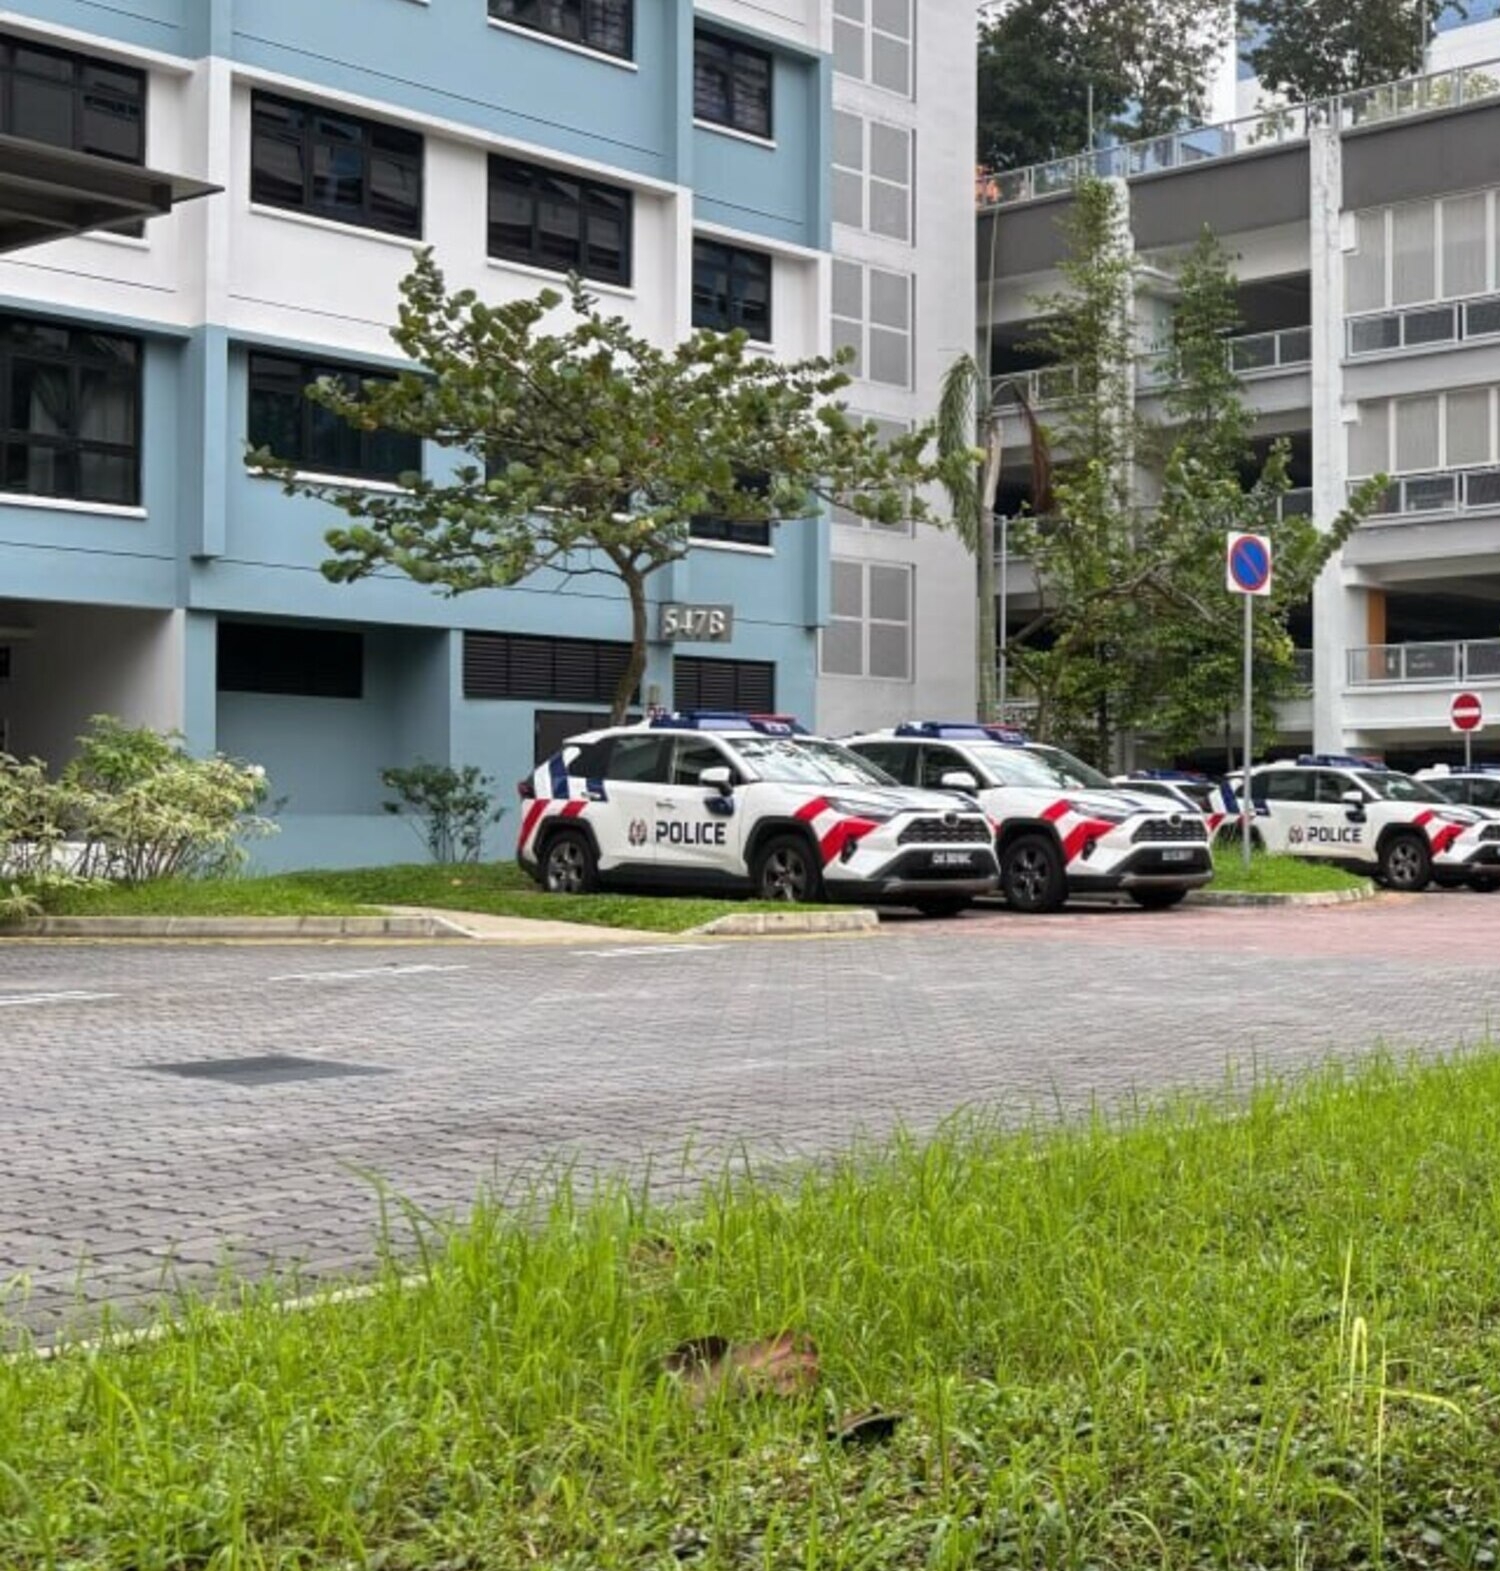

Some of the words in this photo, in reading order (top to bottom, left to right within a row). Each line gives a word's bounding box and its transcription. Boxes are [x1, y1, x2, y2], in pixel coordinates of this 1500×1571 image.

[664, 608, 725, 635] 547B
[656, 822, 726, 845] POLICE
[1308, 826, 1362, 842] POLICE
